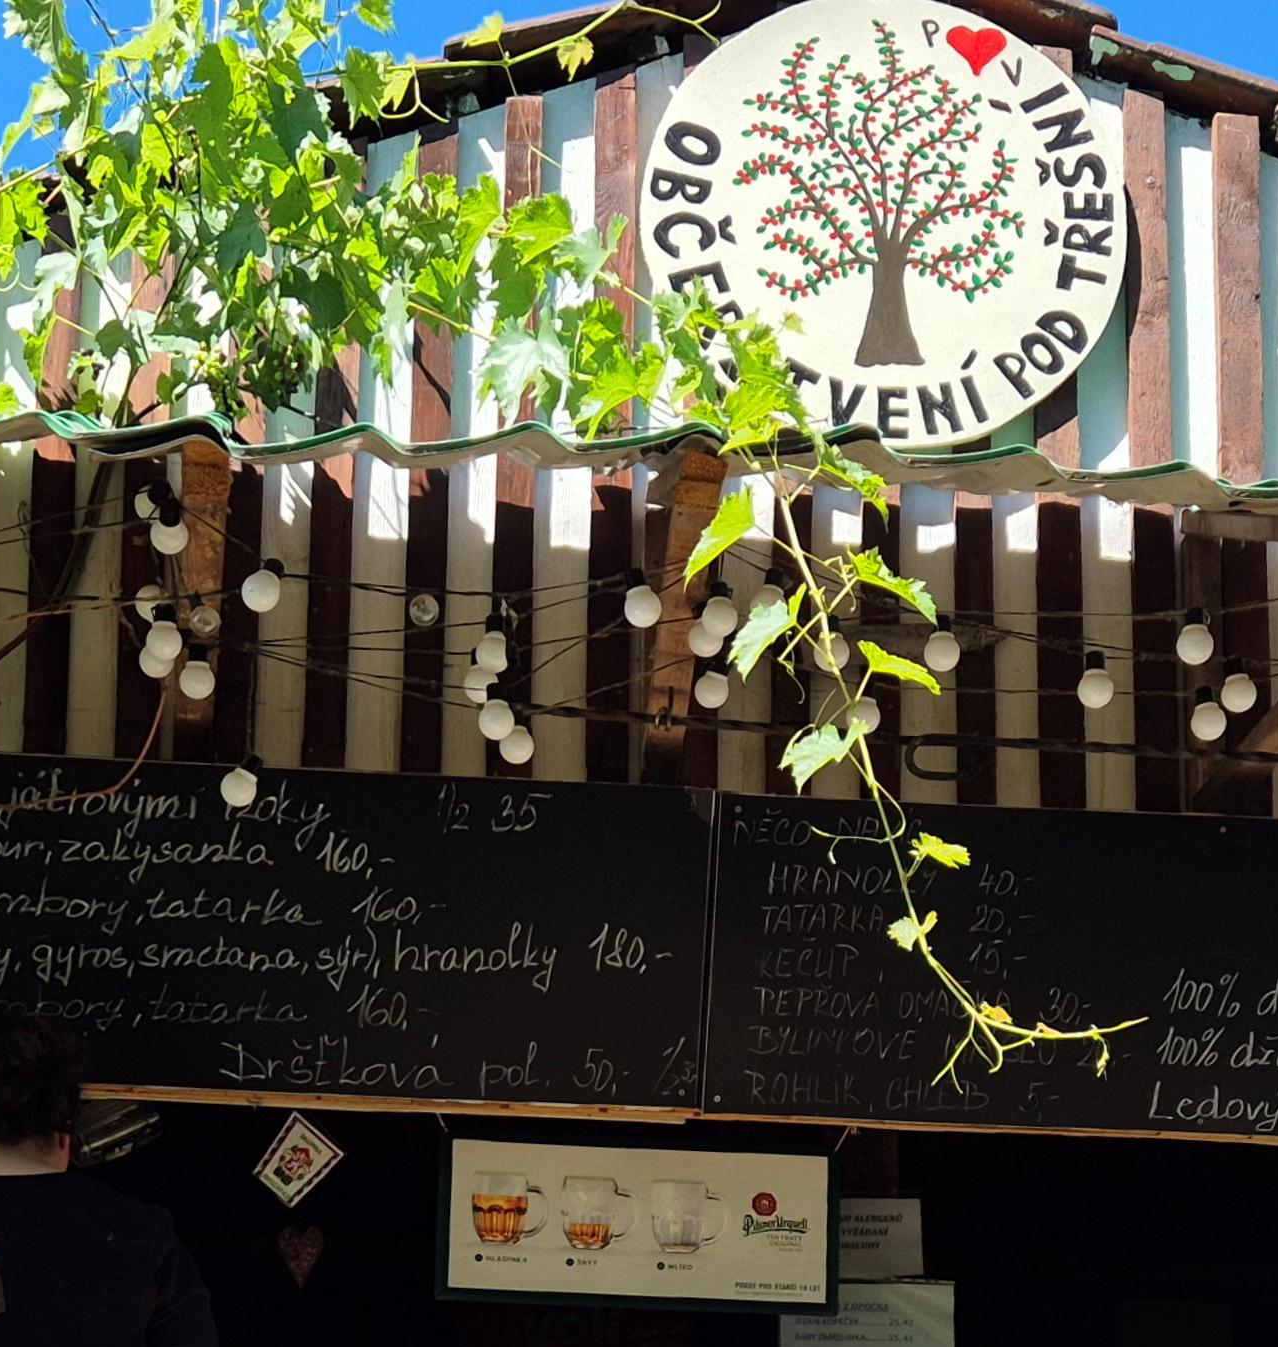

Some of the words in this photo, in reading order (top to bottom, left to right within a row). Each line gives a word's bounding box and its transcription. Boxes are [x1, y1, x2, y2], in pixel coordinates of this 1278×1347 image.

[994, 310, 1089, 399] POD
[392, 922, 559, 995] hranolky
[1163, 968, 1240, 1019] 100%
[1156, 1027, 1225, 1070] 100%
